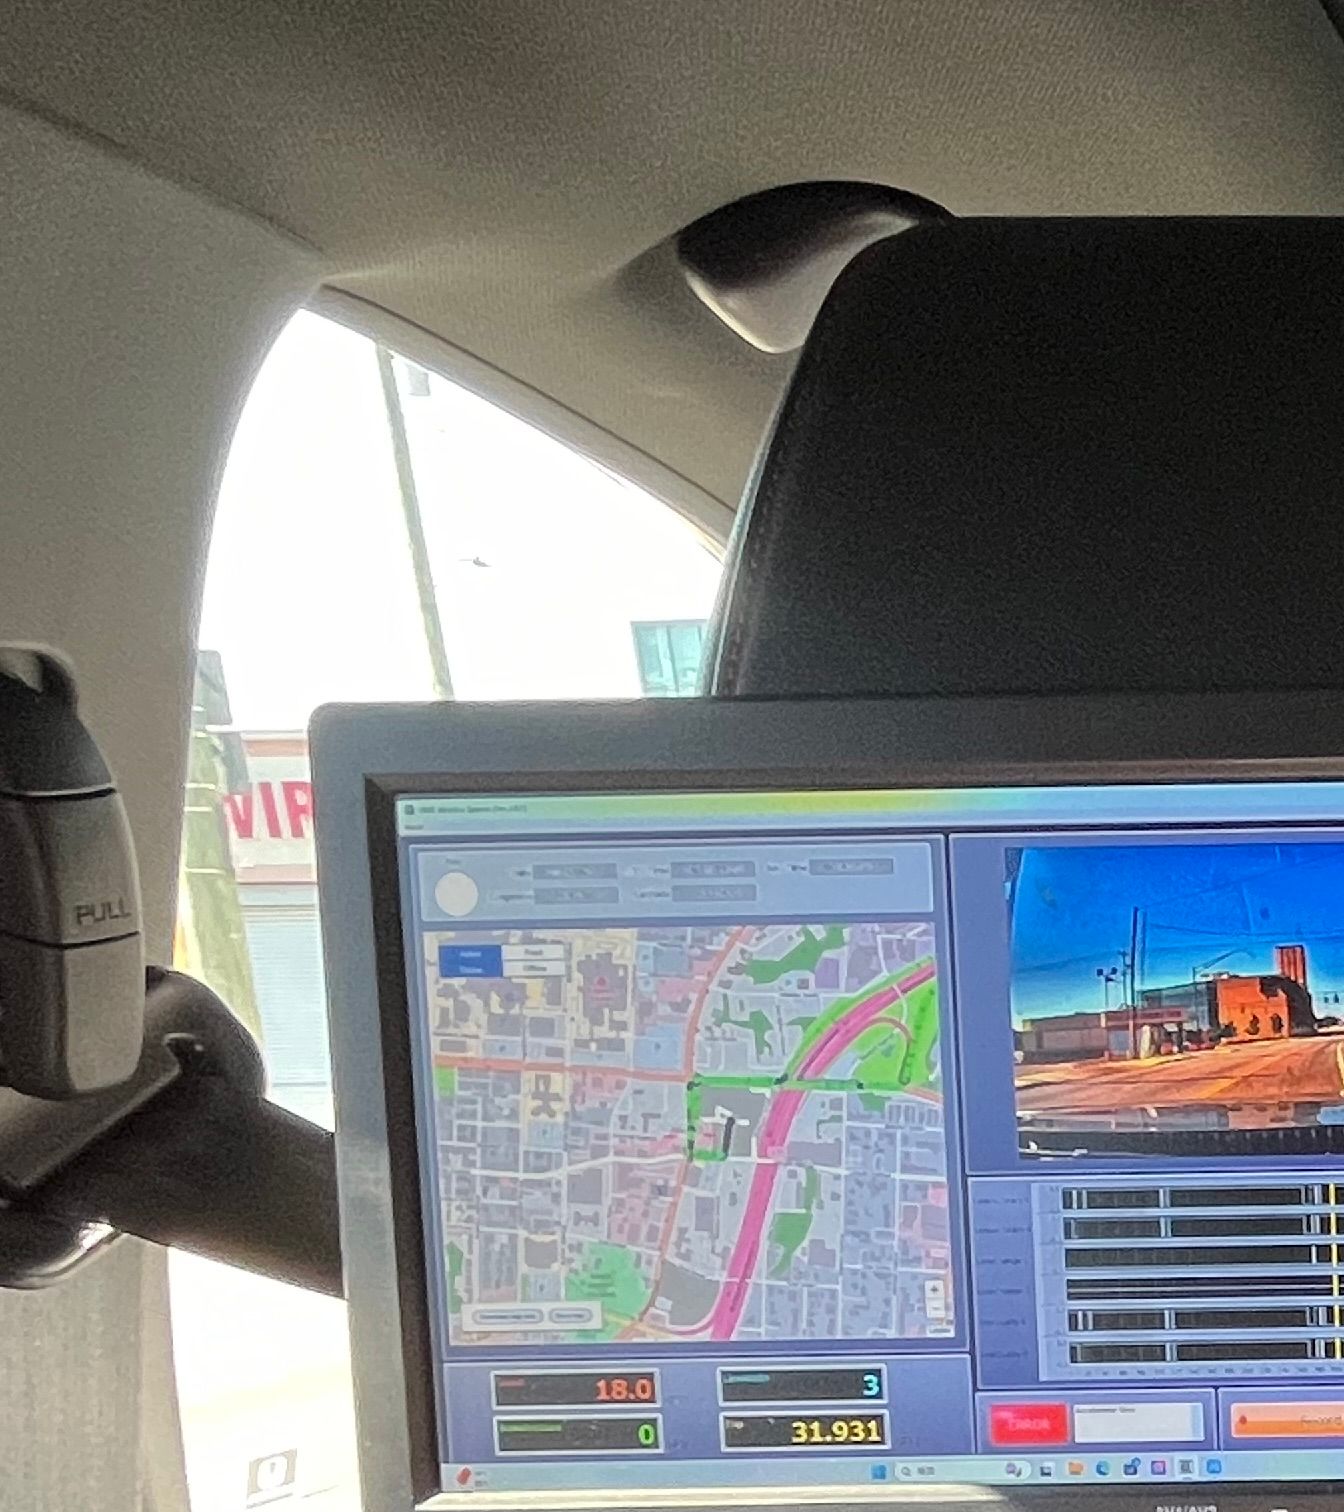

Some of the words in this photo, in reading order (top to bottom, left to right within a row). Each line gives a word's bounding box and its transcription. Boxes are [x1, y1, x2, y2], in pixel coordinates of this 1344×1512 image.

[75, 897, 132, 925] PULL
[596, 1378, 653, 1400] 18.0
[863, 1374, 880, 1397] 3
[638, 1424, 655, 1445] 0
[791, 1420, 882, 1444] 31.931
